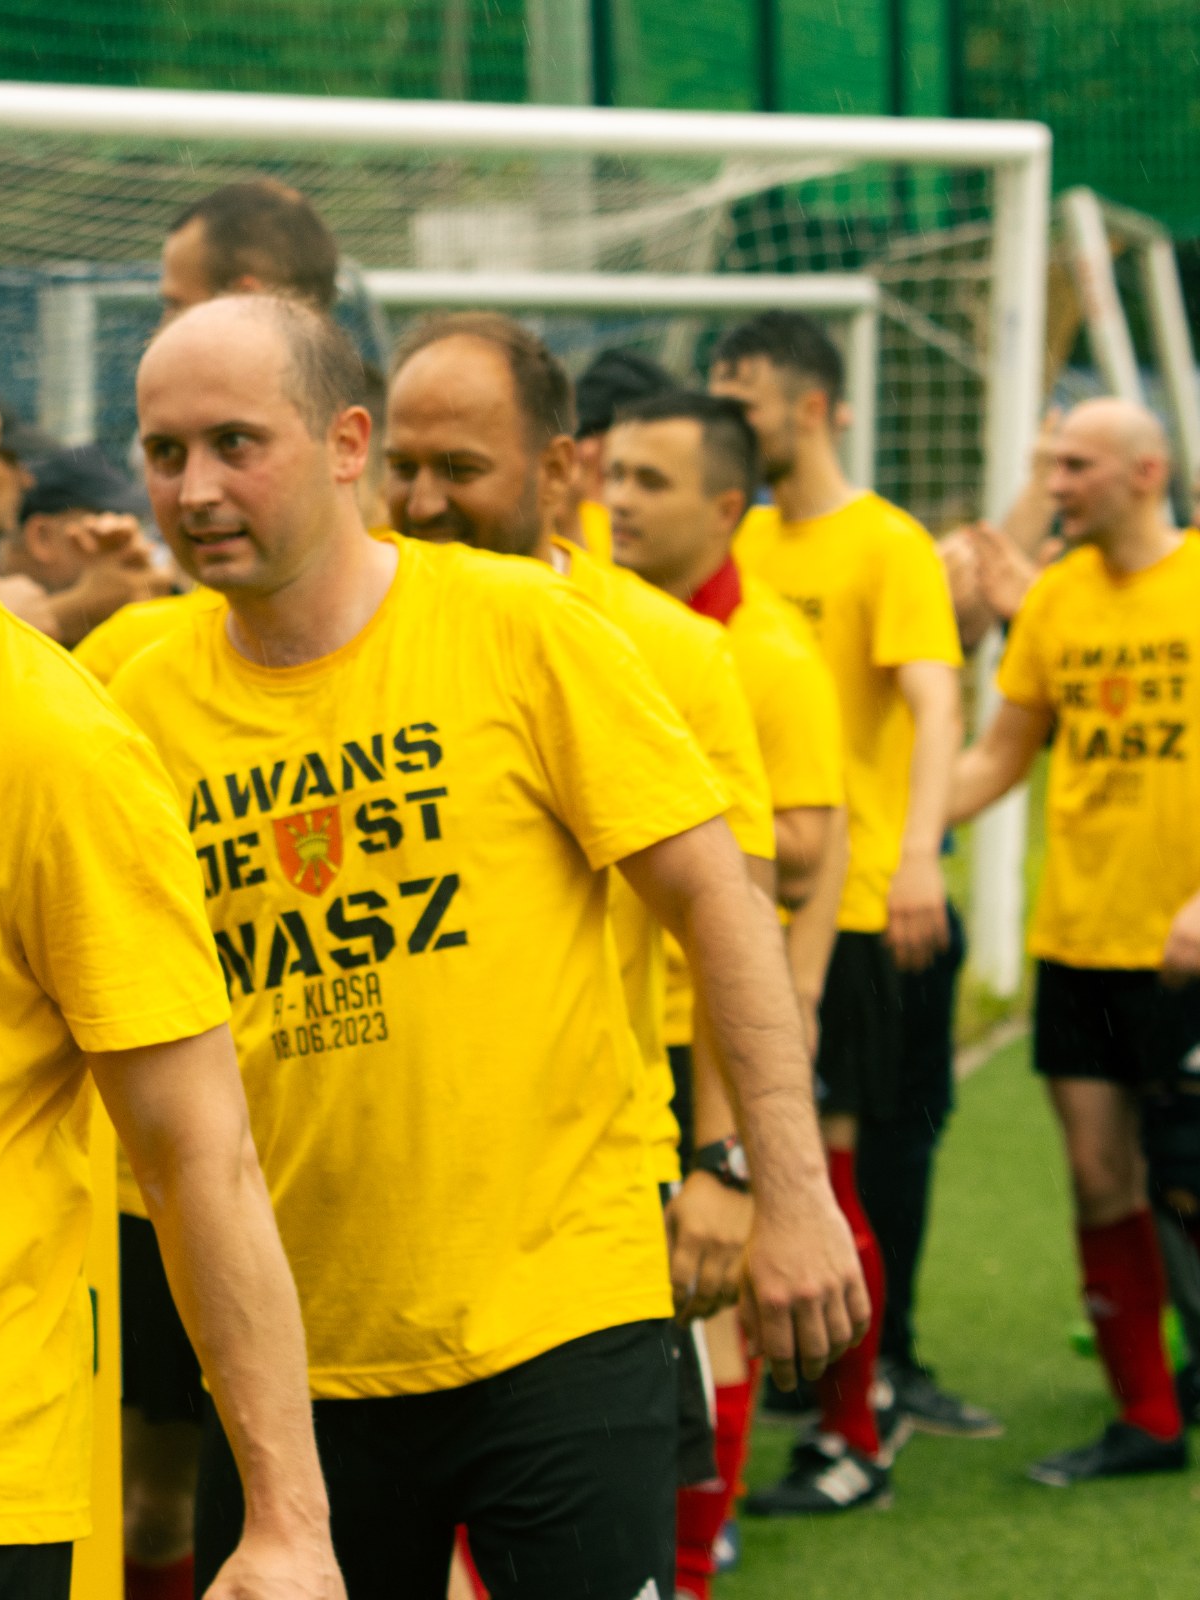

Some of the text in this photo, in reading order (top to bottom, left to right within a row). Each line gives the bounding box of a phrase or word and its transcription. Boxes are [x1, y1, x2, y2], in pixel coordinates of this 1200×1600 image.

[188, 722, 443, 834] AWANS
[354, 786, 448, 855] ST
[213, 873, 468, 1002] NASZ
[303, 972, 382, 1020] KLASA
[272, 1011, 388, 1061] 18.06.2023
